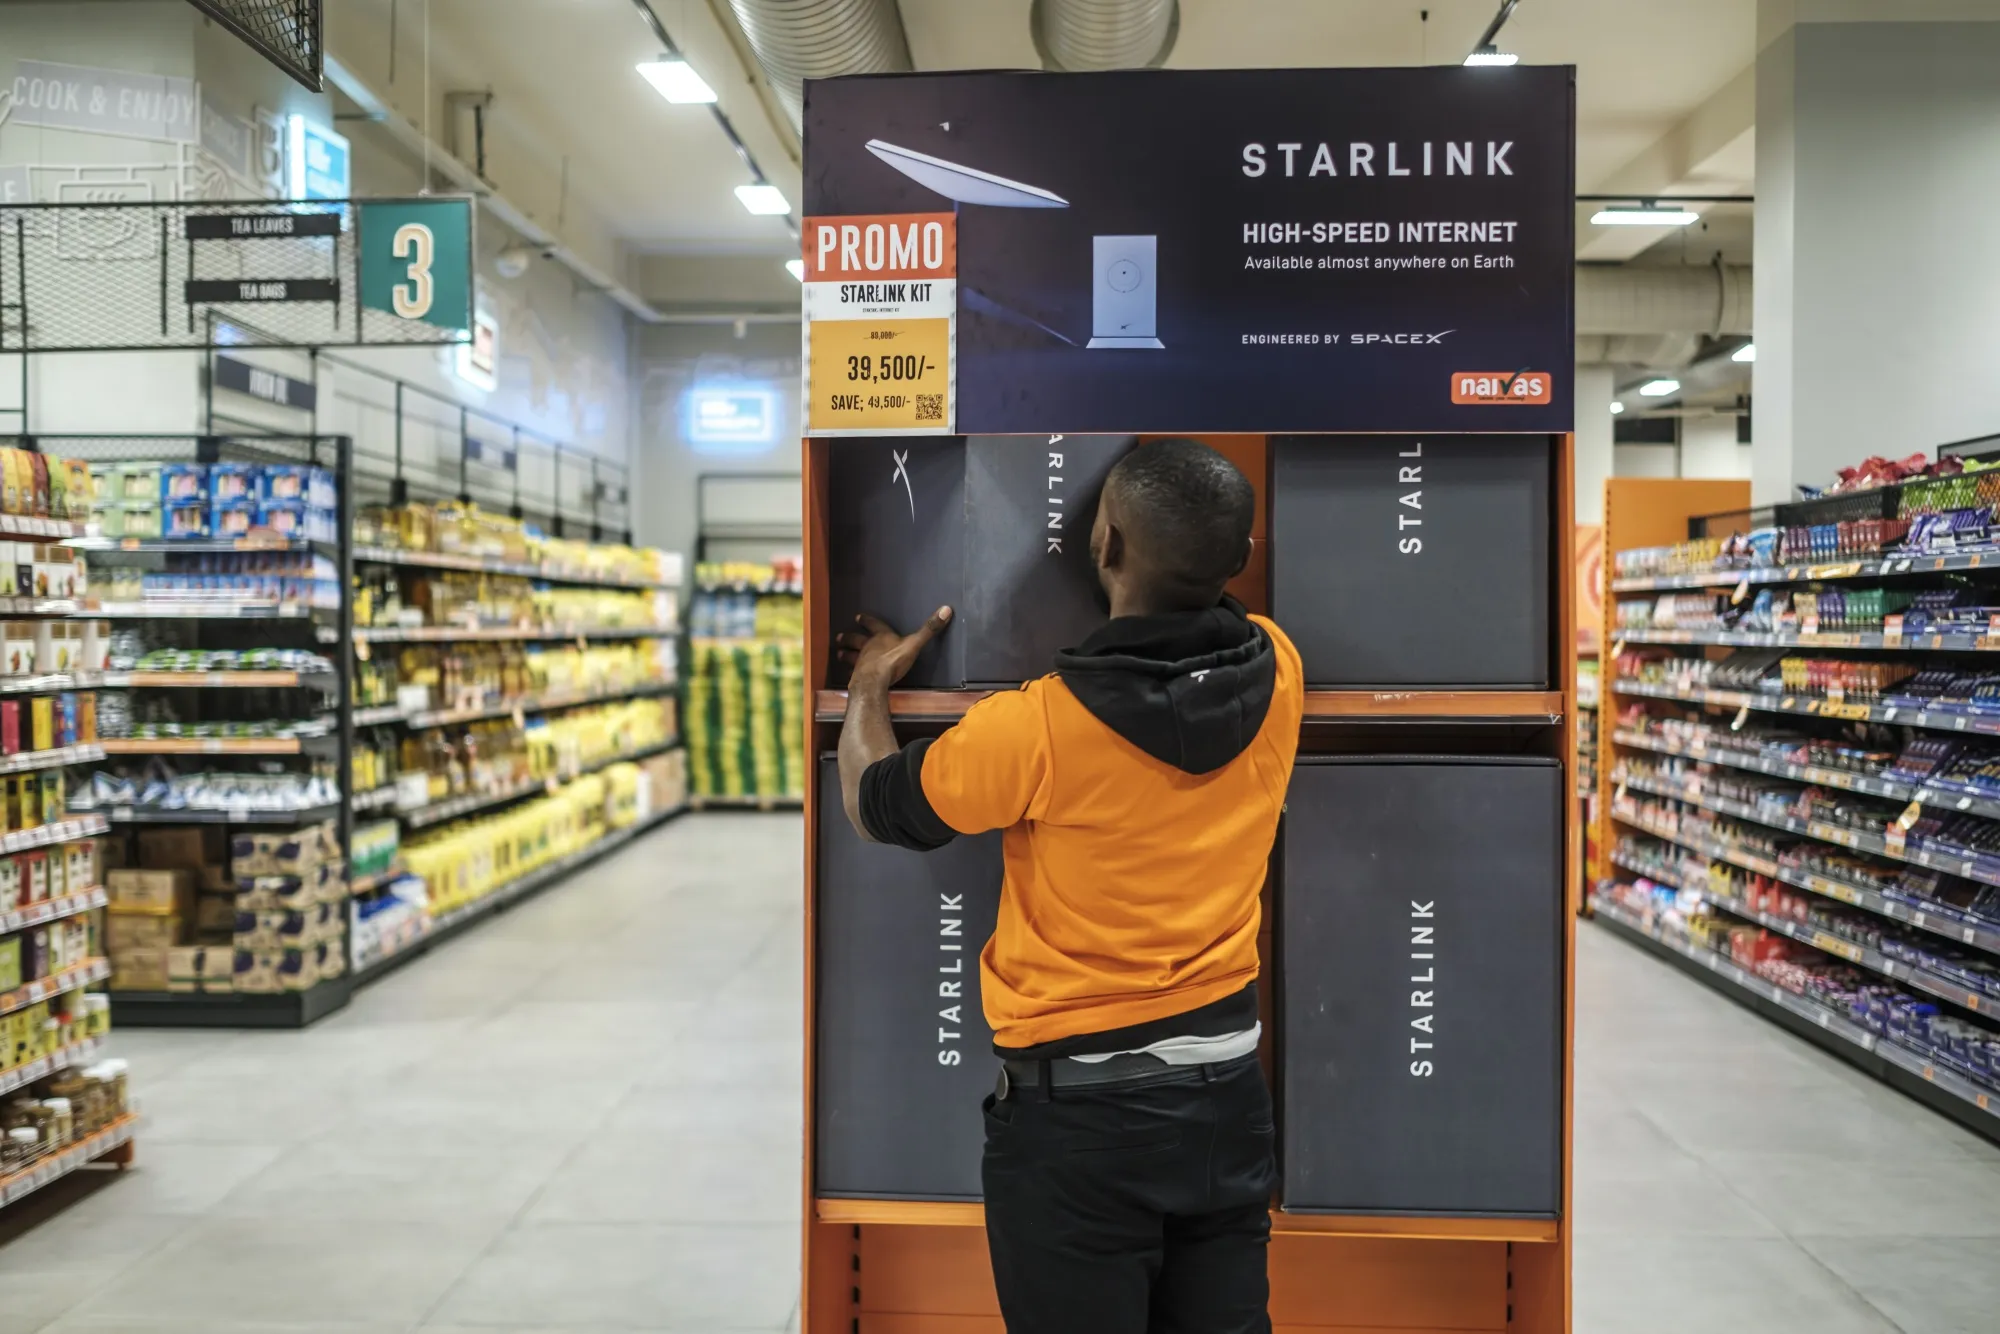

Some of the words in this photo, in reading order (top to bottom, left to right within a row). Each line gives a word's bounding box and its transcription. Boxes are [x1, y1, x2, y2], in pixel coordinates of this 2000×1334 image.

[13, 76, 81, 112] COOK
[88, 85, 106, 115] &
[118, 88, 195, 125] ENJOY
[1242, 141, 1514, 178] STARLINK
[231, 217, 250, 234] TEA
[253, 217, 294, 234] LEAVES
[1243, 222, 1390, 244] HIGH-SPEED
[1398, 221, 1518, 243] INTERNET
[817, 221, 943, 272] PROMO
[392, 223, 434, 319] 3
[1244, 255, 1313, 270] Available
[1317, 256, 1370, 270] almost
[1374, 256, 1446, 272] anywhere
[1451, 257, 1469, 269] on
[1474, 254, 1514, 269] Earth
[239, 283, 258, 299] TEA
[840, 283, 906, 303] STARLINK
[911, 283, 932, 302] KIT
[1242, 334, 1320, 344] ENGINEERED
[1324, 334, 1340, 344] BY
[1351, 329, 1457, 344] SPACEX
[847, 355, 935, 384] 39,500/-
[831, 394, 864, 412] SAVE;
[938, 893, 963, 1066] STARLINK
[1410, 900, 1434, 1077] STARLINK
